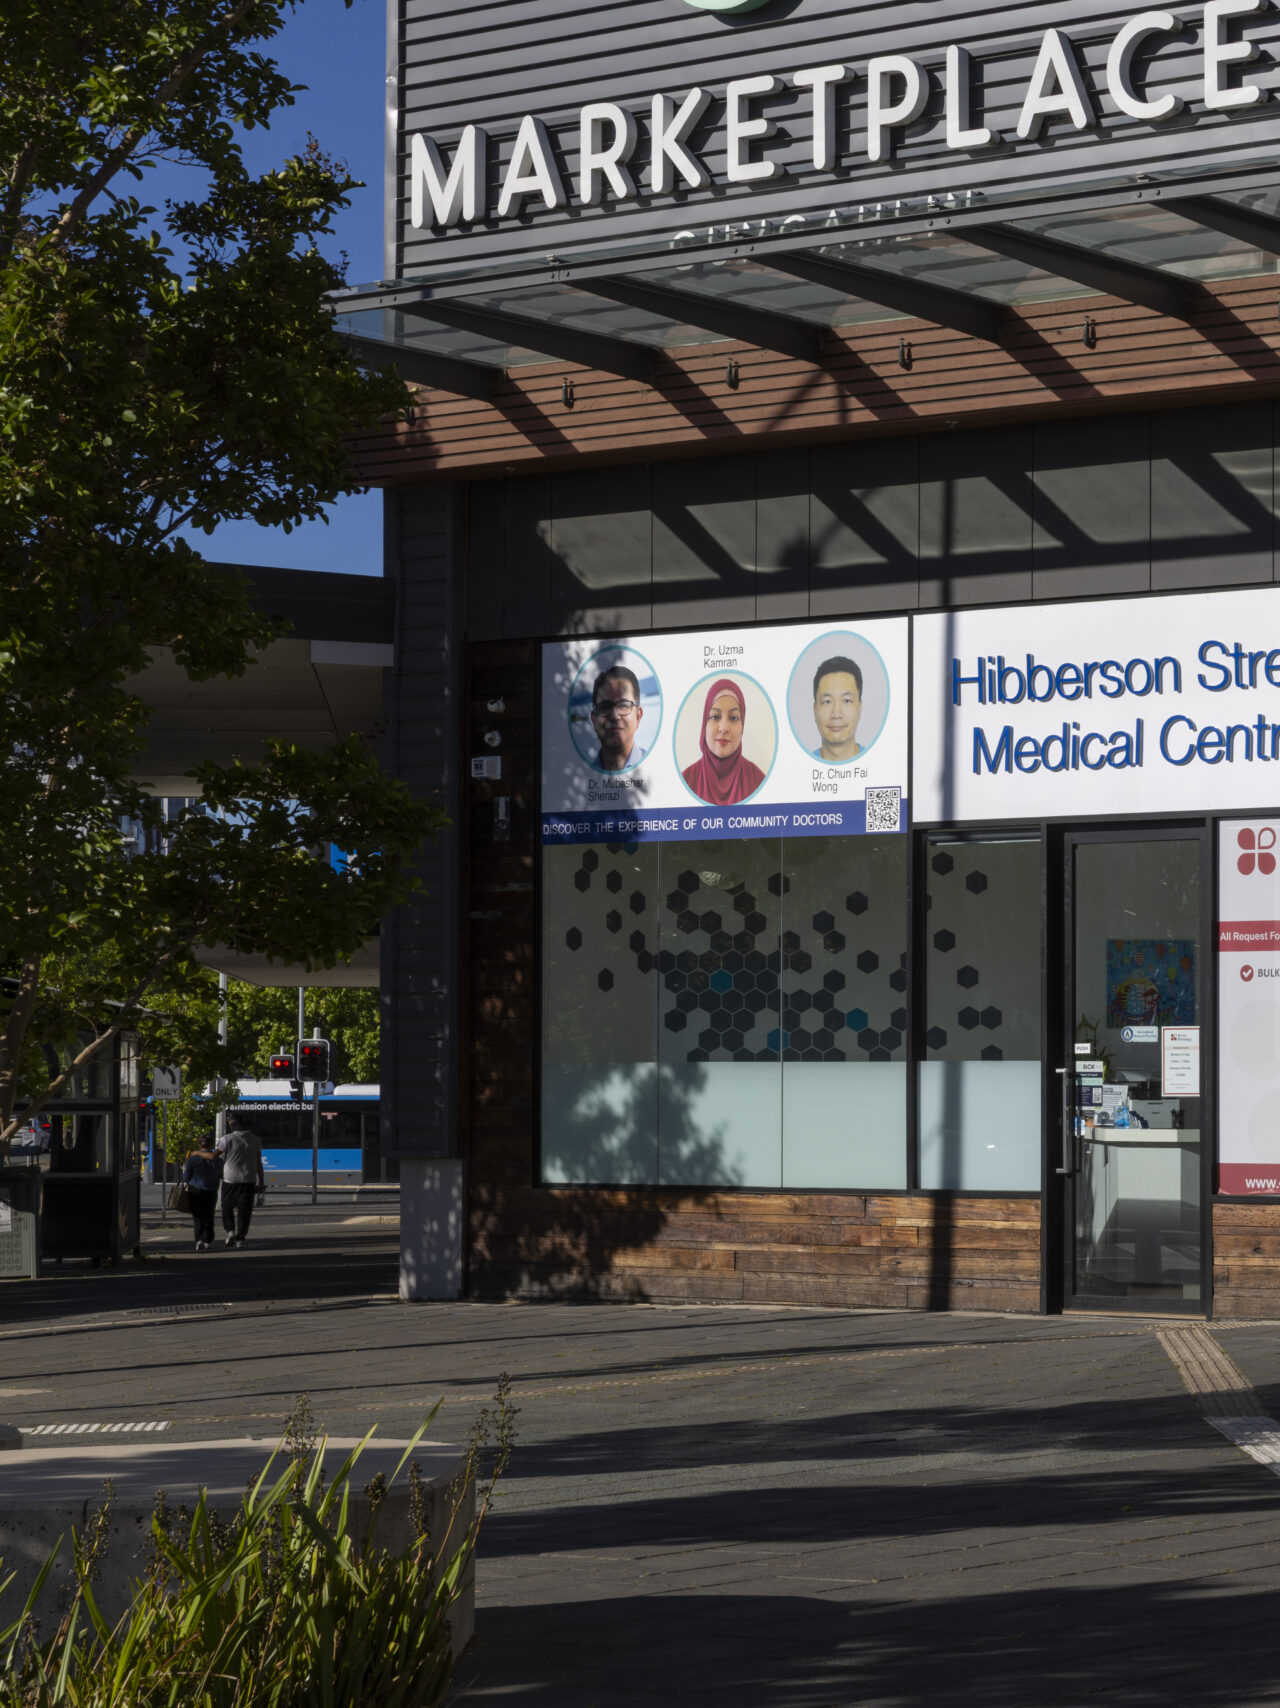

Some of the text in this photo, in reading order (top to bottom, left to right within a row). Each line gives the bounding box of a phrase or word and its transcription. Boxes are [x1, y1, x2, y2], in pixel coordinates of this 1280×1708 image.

[411, 0, 1270, 231] MARKETPLACE
[703, 644, 744, 656] Dr. Uzma
[703, 657, 738, 668] Kamran
[952, 653, 1181, 706] Hibberson
[972, 718, 1143, 775] Medical
[812, 767, 868, 780] Dr. Chun Fai
[588, 777, 644, 789] Dr. Mubashar
[812, 782, 838, 794] Wong
[588, 790, 620, 801] Sherazi
[542, 813, 843, 835] DISCOVER THE EXPERIENCE OF OUR COMMUNITY DOCTORS
[1219, 931, 1232, 941] All
[1233, 931, 1269, 943] Request
[1257, 968, 1280, 978] BULK
[155, 1088, 178, 1096] ONLY
[230, 1102, 268, 1111] emission
[268, 1102, 301, 1111] electric
